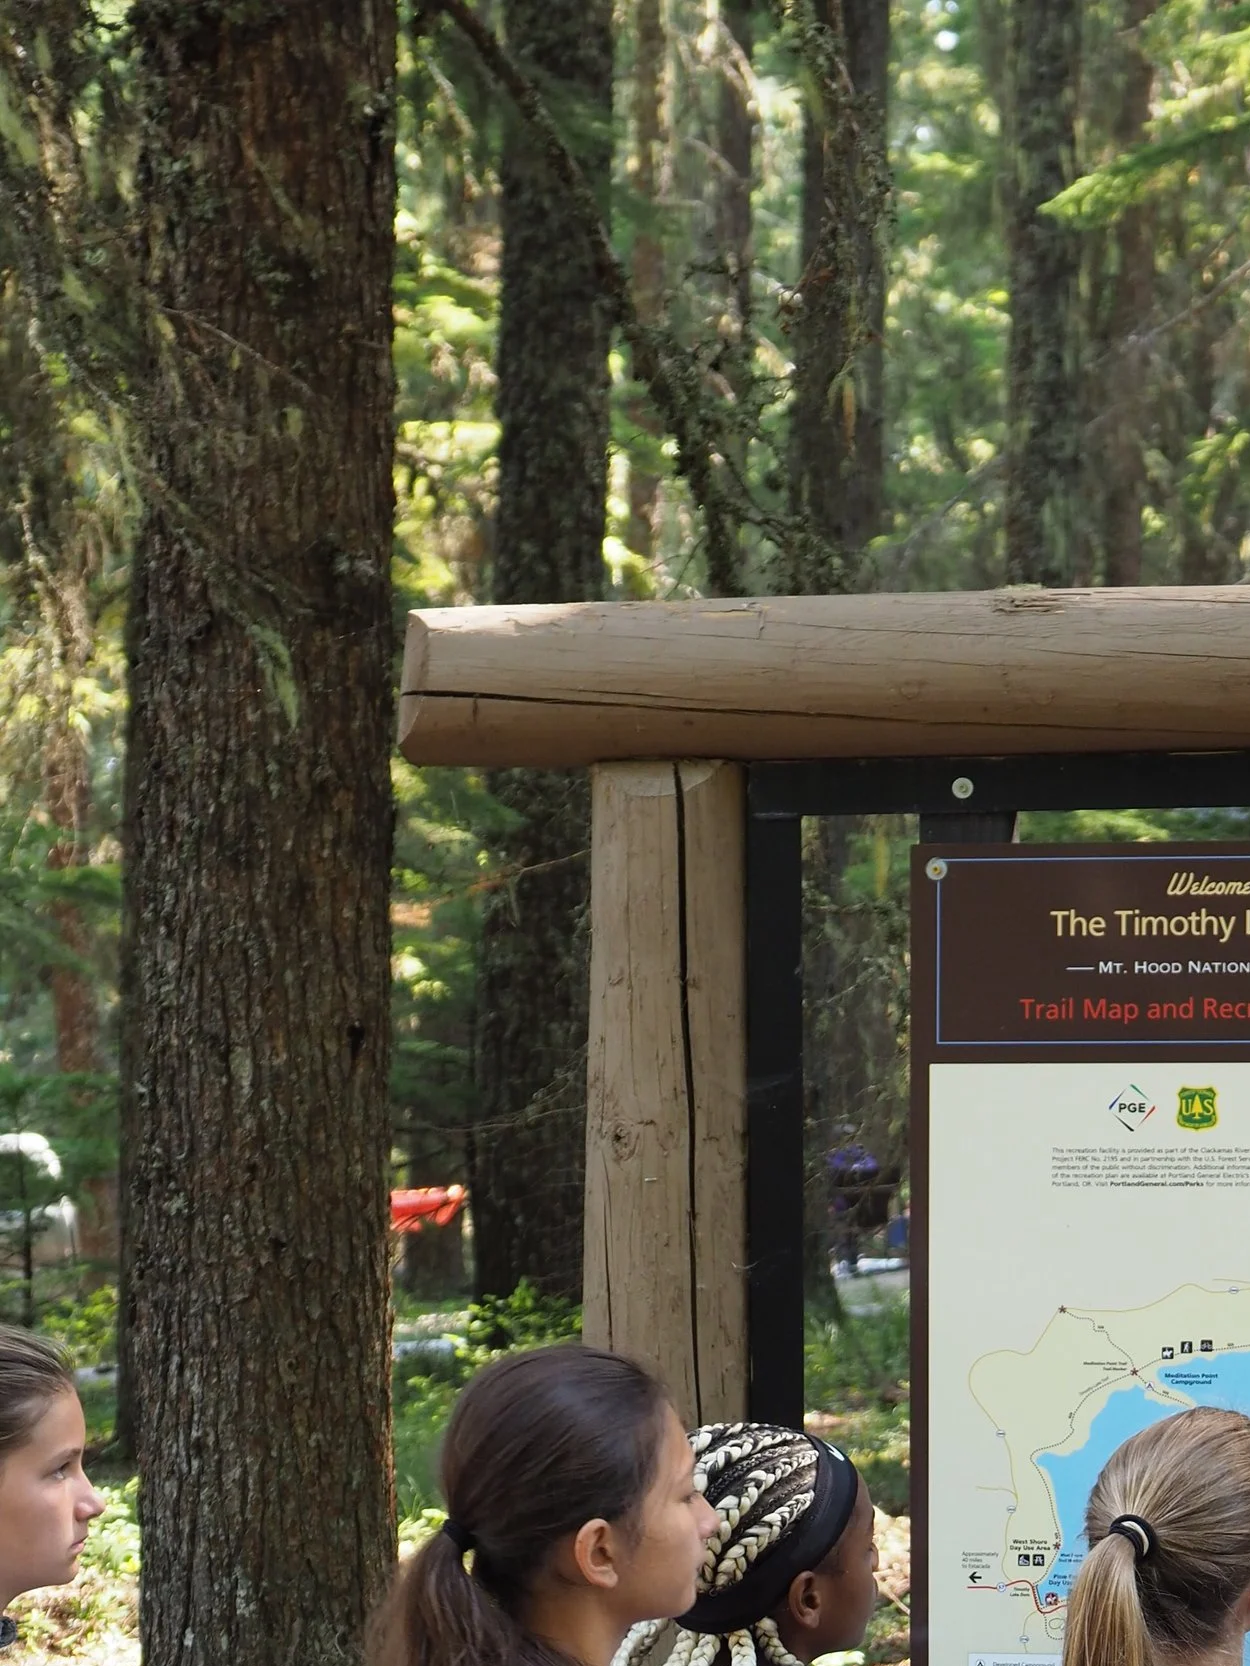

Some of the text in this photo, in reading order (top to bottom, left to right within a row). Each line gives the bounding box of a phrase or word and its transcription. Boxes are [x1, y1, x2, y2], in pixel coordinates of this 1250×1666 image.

[1049, 908, 1107, 937] The
[1113, 907, 1237, 944] Timothy
[1019, 996, 1074, 1020] Trail
[1083, 997, 1139, 1025] Map
[1147, 996, 1195, 1020] and
[1118, 1102, 1146, 1113] PGE
